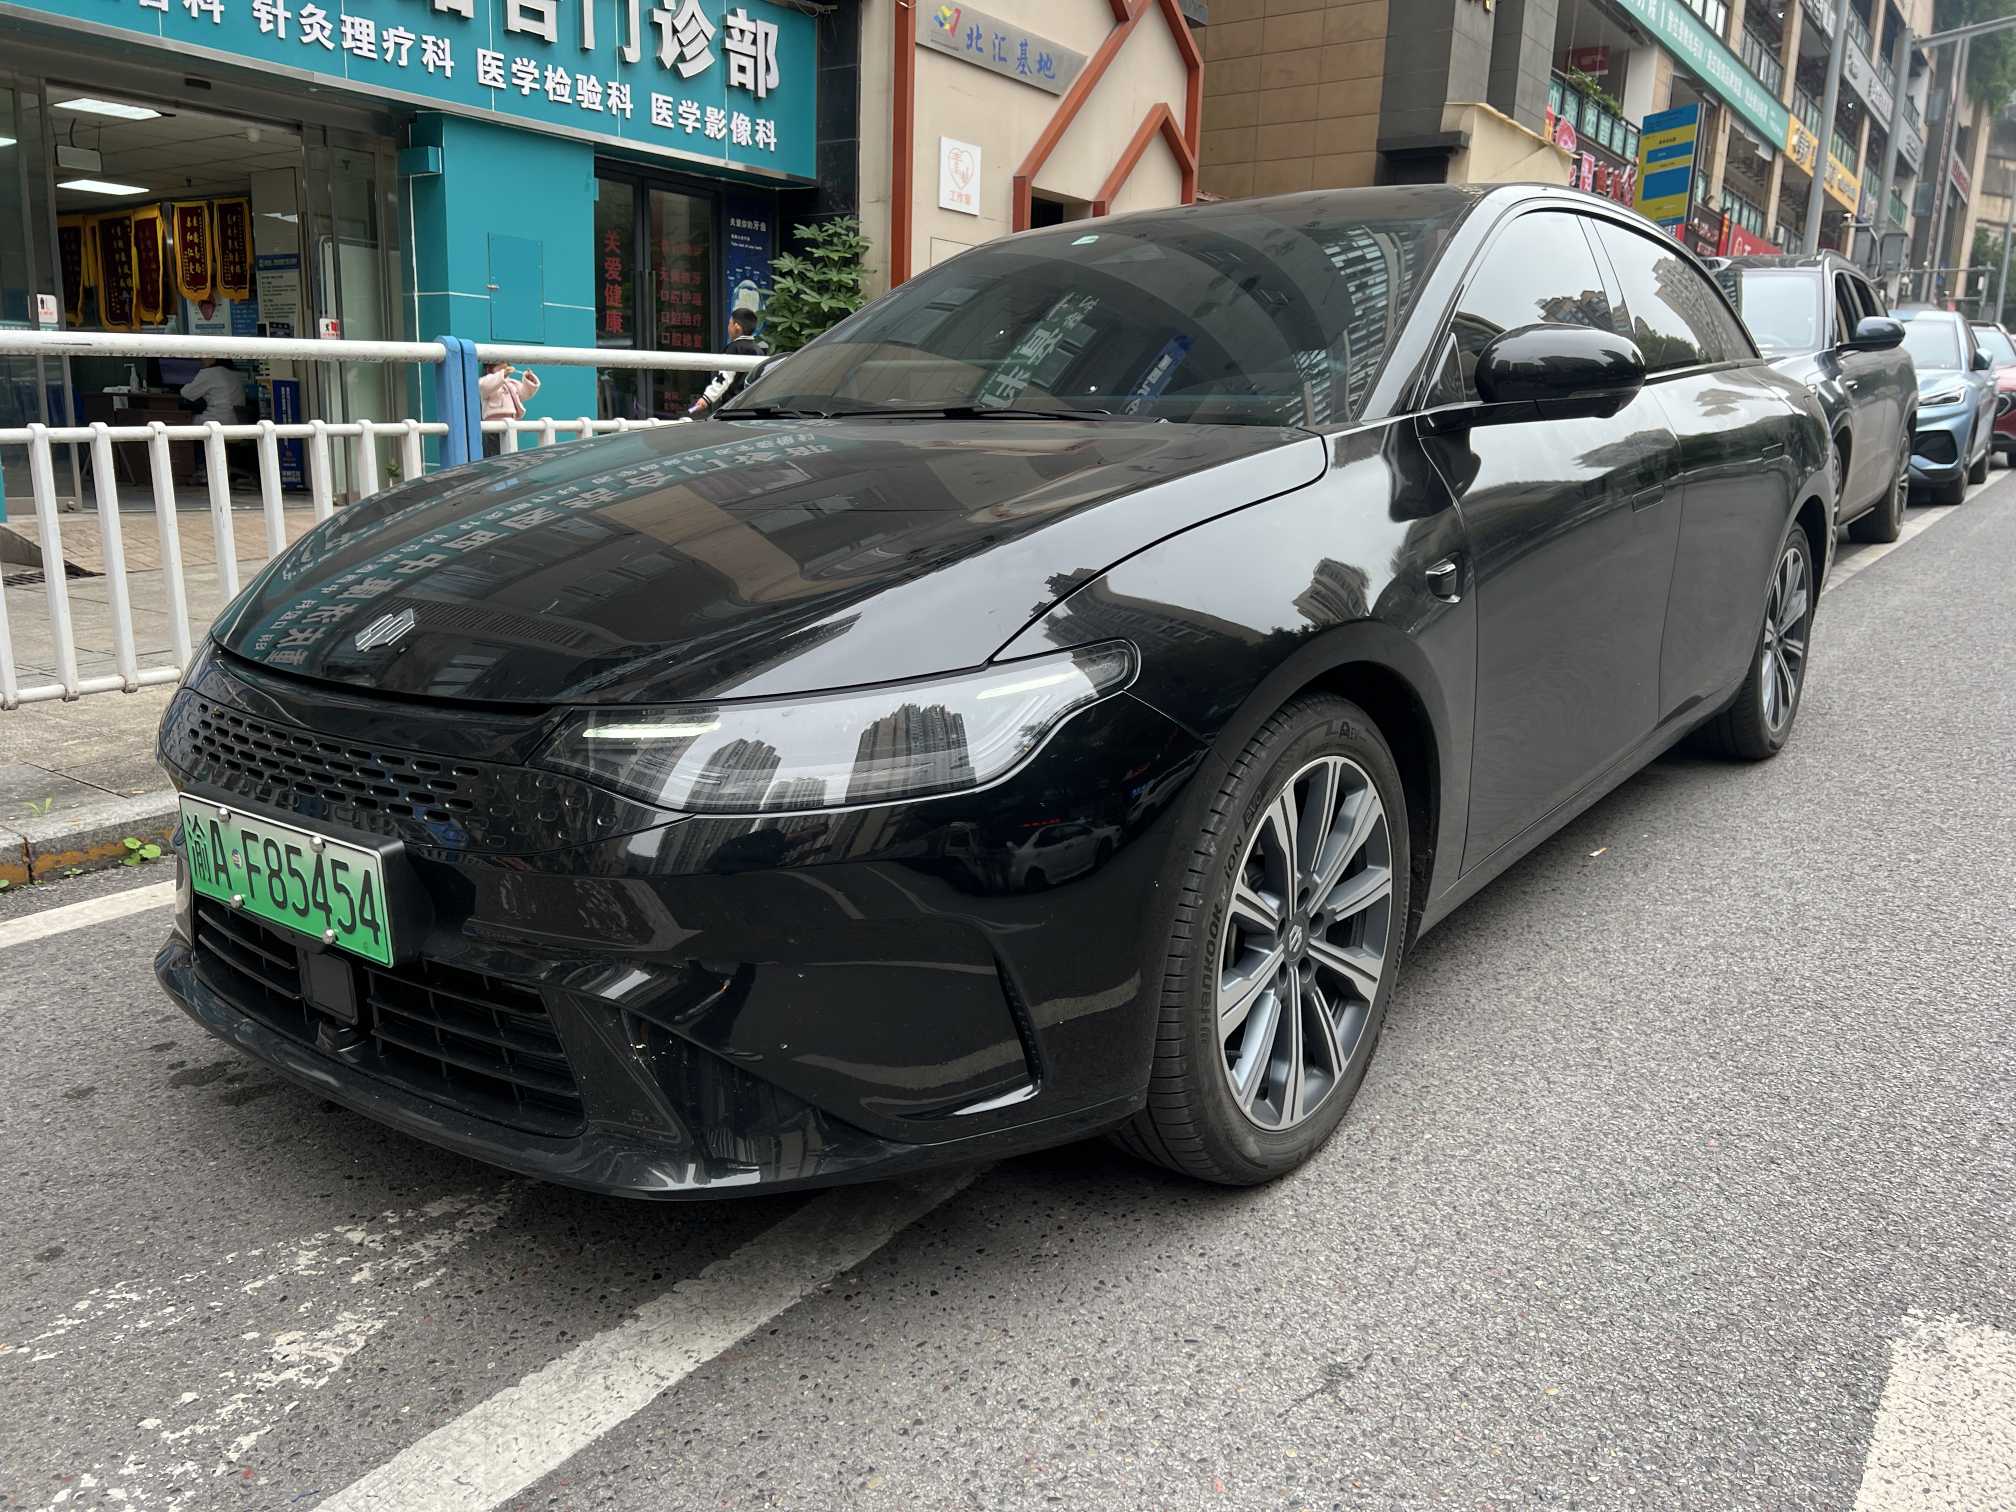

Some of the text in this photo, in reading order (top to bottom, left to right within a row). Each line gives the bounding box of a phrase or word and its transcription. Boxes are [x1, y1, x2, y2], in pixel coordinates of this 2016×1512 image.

[252, 0, 454, 78] 针灸理疗科
[476, 47, 634, 119] 医学检验科
[650, 91, 778, 152] 医学影像科
[965, 22, 1057, 81] 北汇基地
[604, 229, 625, 334] 关爱健康
